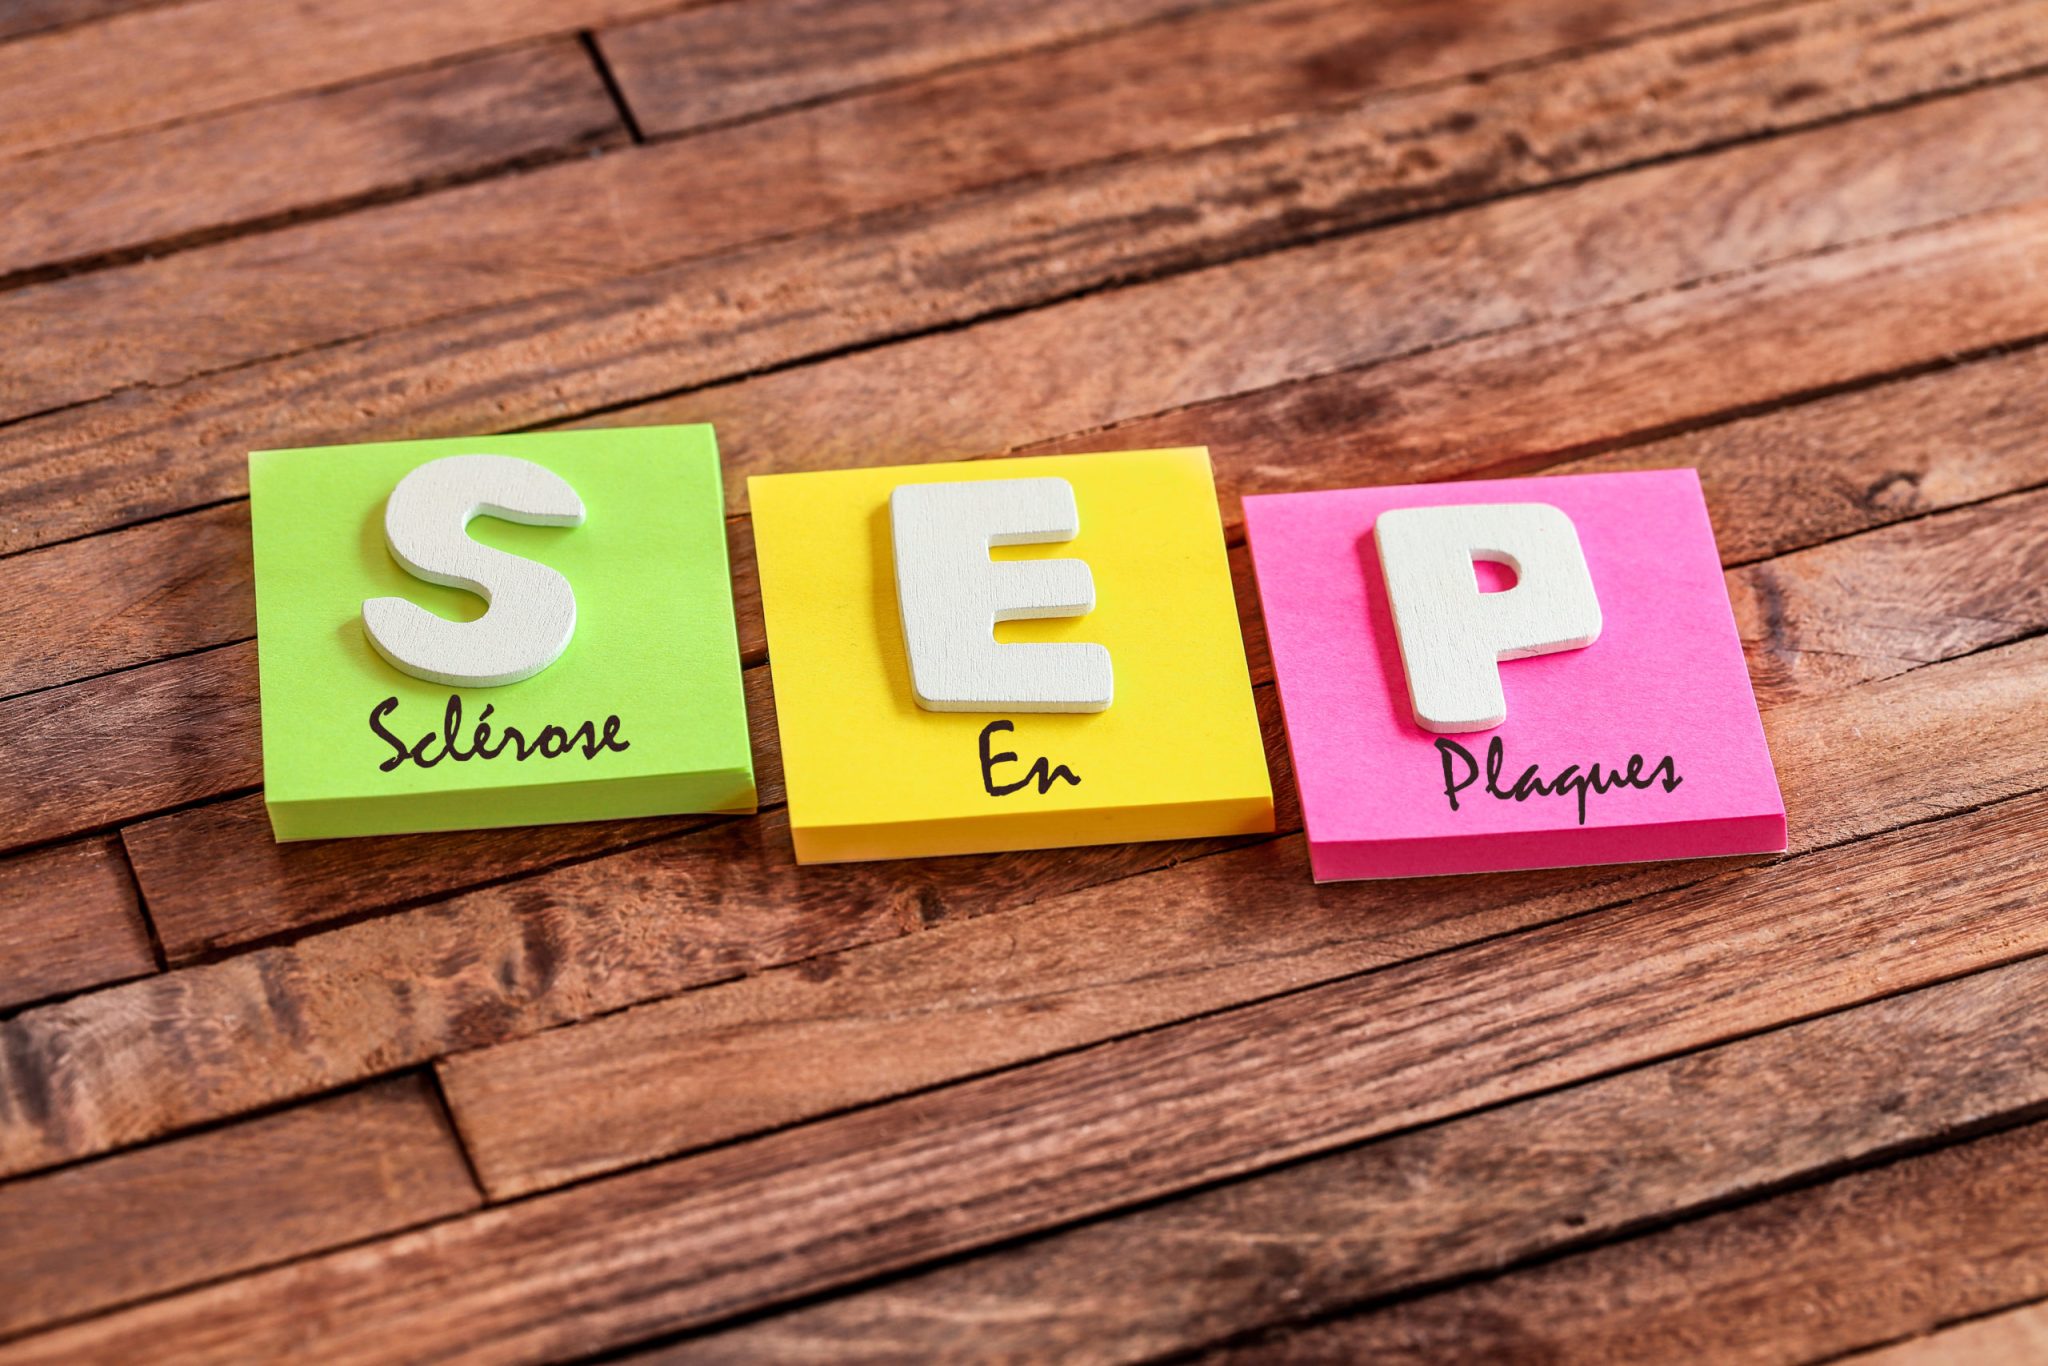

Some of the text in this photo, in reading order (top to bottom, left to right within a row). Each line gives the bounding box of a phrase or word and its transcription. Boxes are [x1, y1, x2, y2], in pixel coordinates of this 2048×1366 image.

[361, 454, 587, 688] S
[890, 476, 1114, 714] E
[1374, 502, 1603, 734] P
[369, 694, 632, 773] Sclérose
[979, 719, 1083, 797] En
[1434, 735, 1684, 825] Plaques
